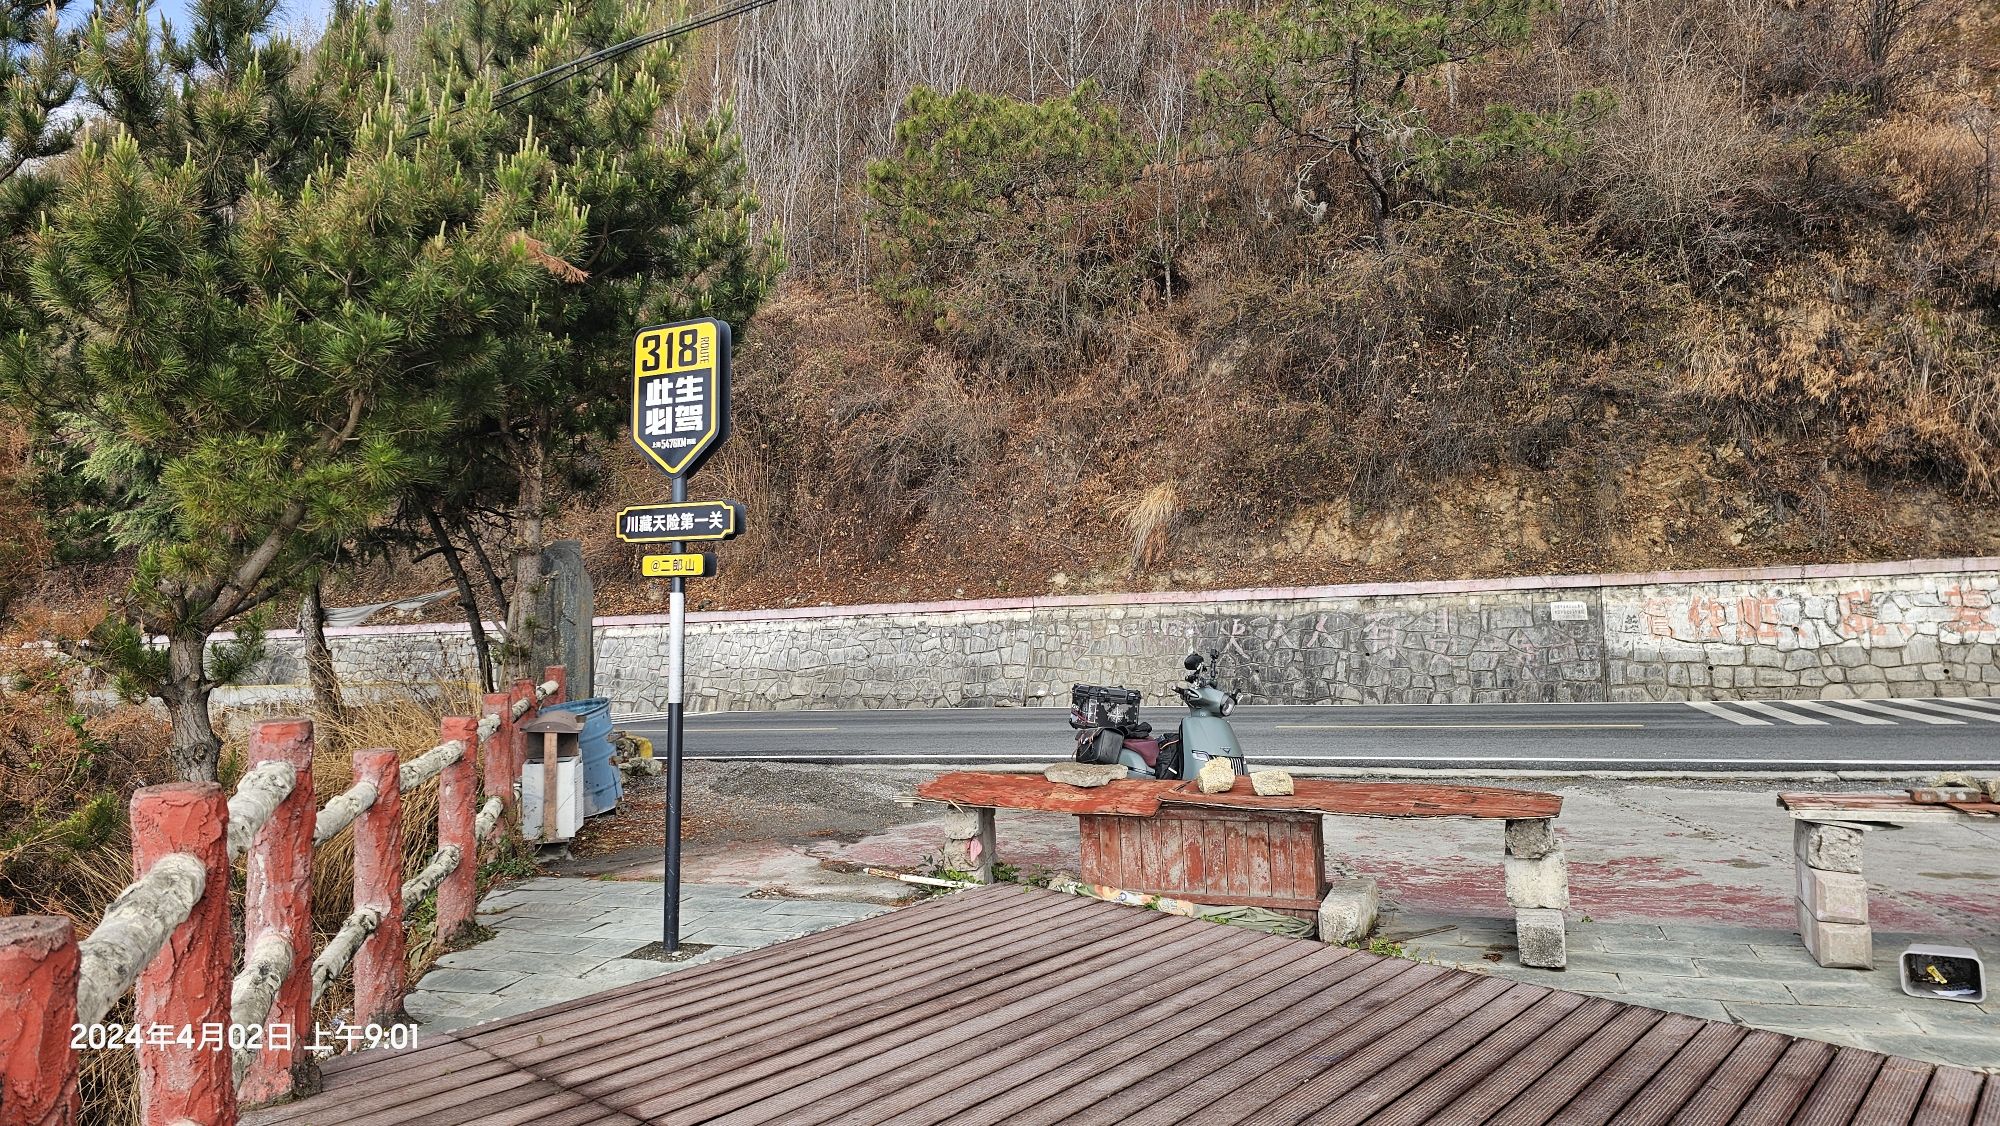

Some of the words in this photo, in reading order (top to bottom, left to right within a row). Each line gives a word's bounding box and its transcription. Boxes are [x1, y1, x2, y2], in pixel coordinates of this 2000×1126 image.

[642, 329, 698, 372] 318
[700, 336, 710, 364] ROUTE
[646, 375, 704, 407] 此生
[645, 404, 703, 436] 必驾
[625, 510, 724, 533] 川藏天险第一关
